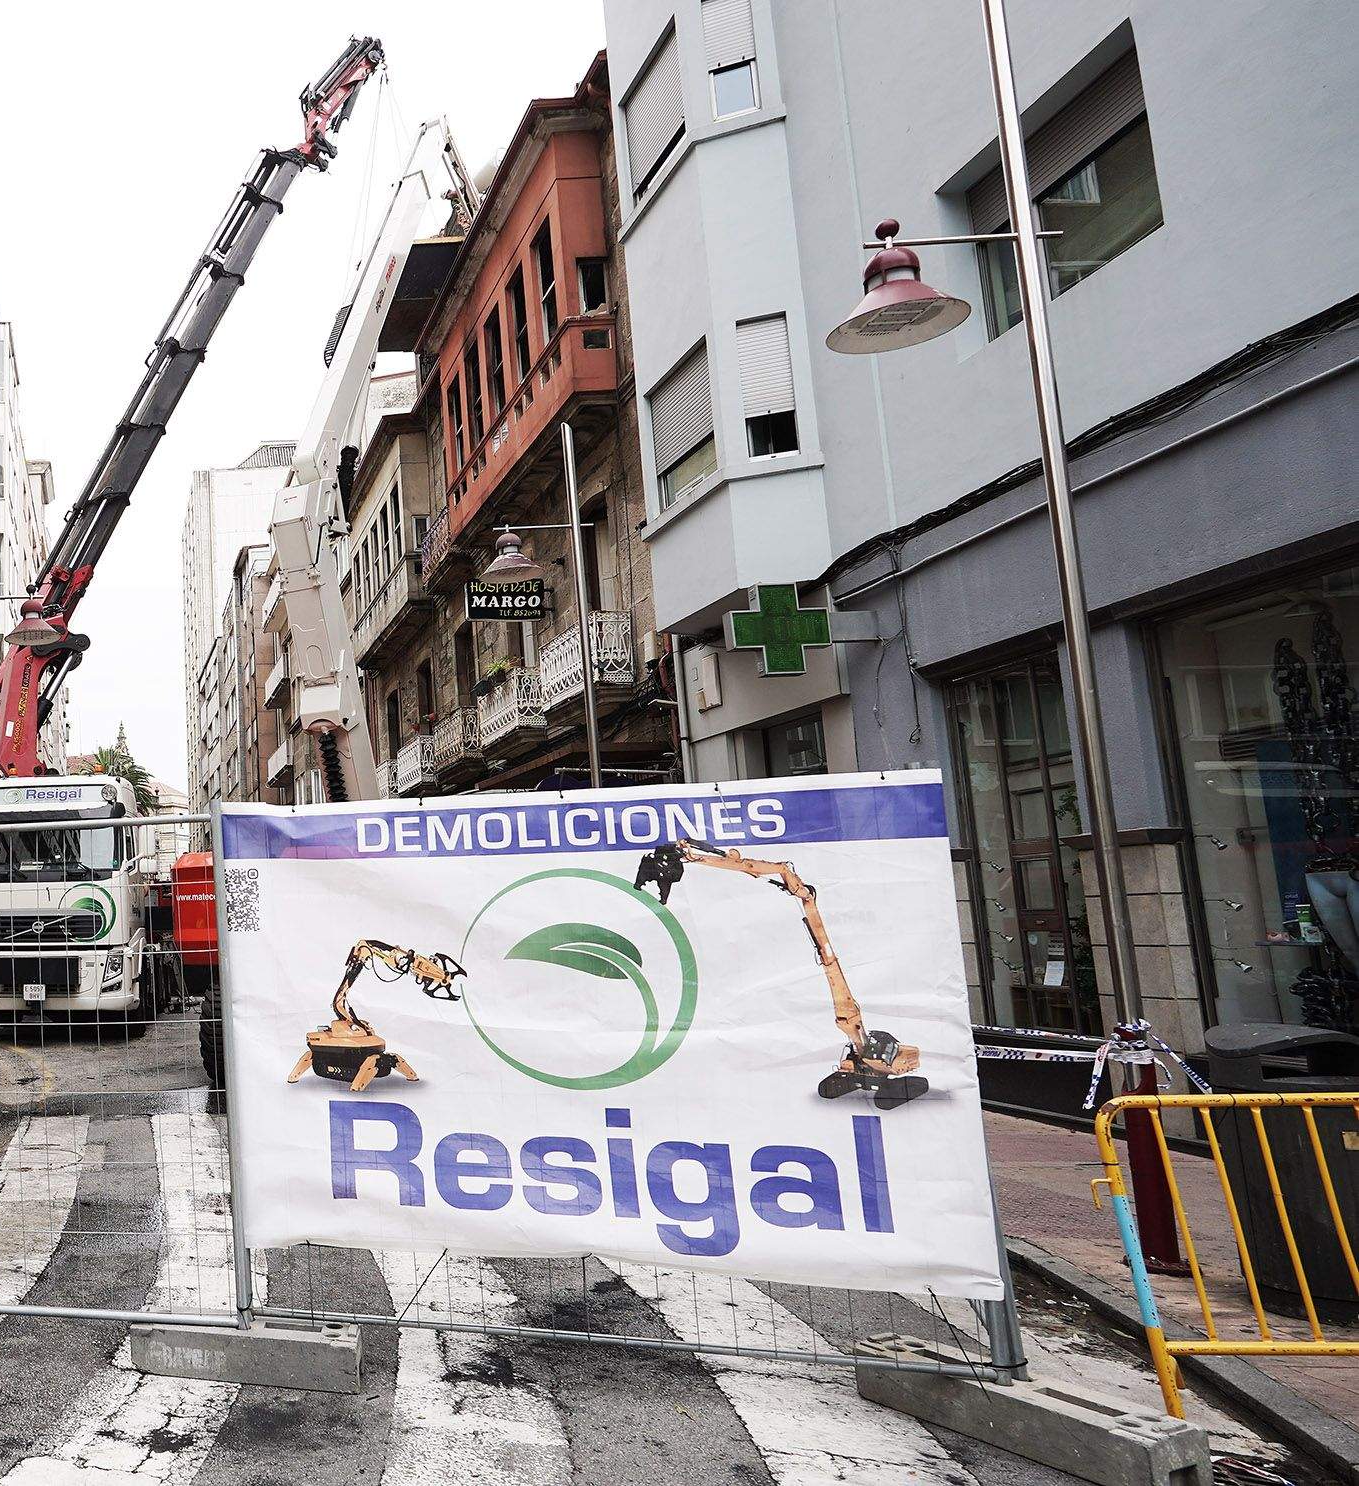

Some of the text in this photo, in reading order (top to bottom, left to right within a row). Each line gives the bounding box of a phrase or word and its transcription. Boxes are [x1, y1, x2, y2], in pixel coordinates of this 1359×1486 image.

[471, 595, 541, 608] MARGO
[25, 788, 82, 801] Resigal
[355, 797, 787, 854] DEMOLICIONES
[329, 1099, 895, 1257] Resigal
